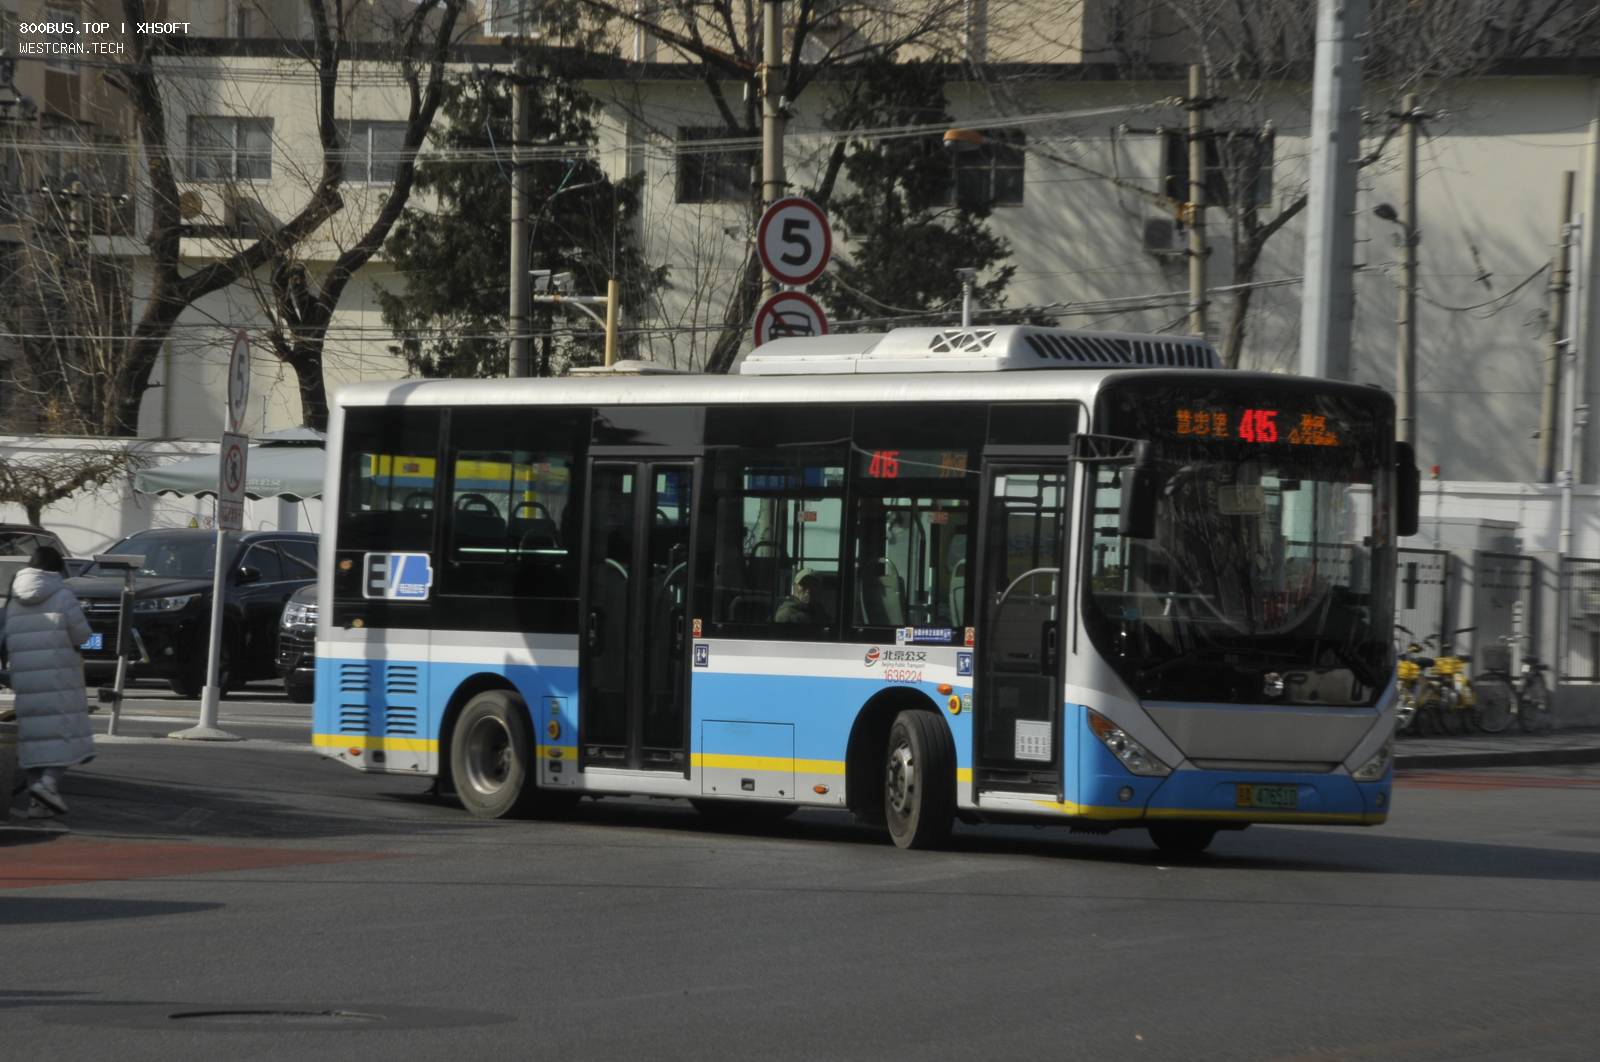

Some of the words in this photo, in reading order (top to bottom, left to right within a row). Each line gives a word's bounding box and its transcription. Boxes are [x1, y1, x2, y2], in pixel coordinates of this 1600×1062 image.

[780, 218, 812, 266] 5
[234, 354, 245, 409] 5
[1238, 409, 1278, 442] 415
[867, 451, 900, 478] 415
[882, 650, 927, 661] 北京公交
[884, 669, 922, 684] 1636224
